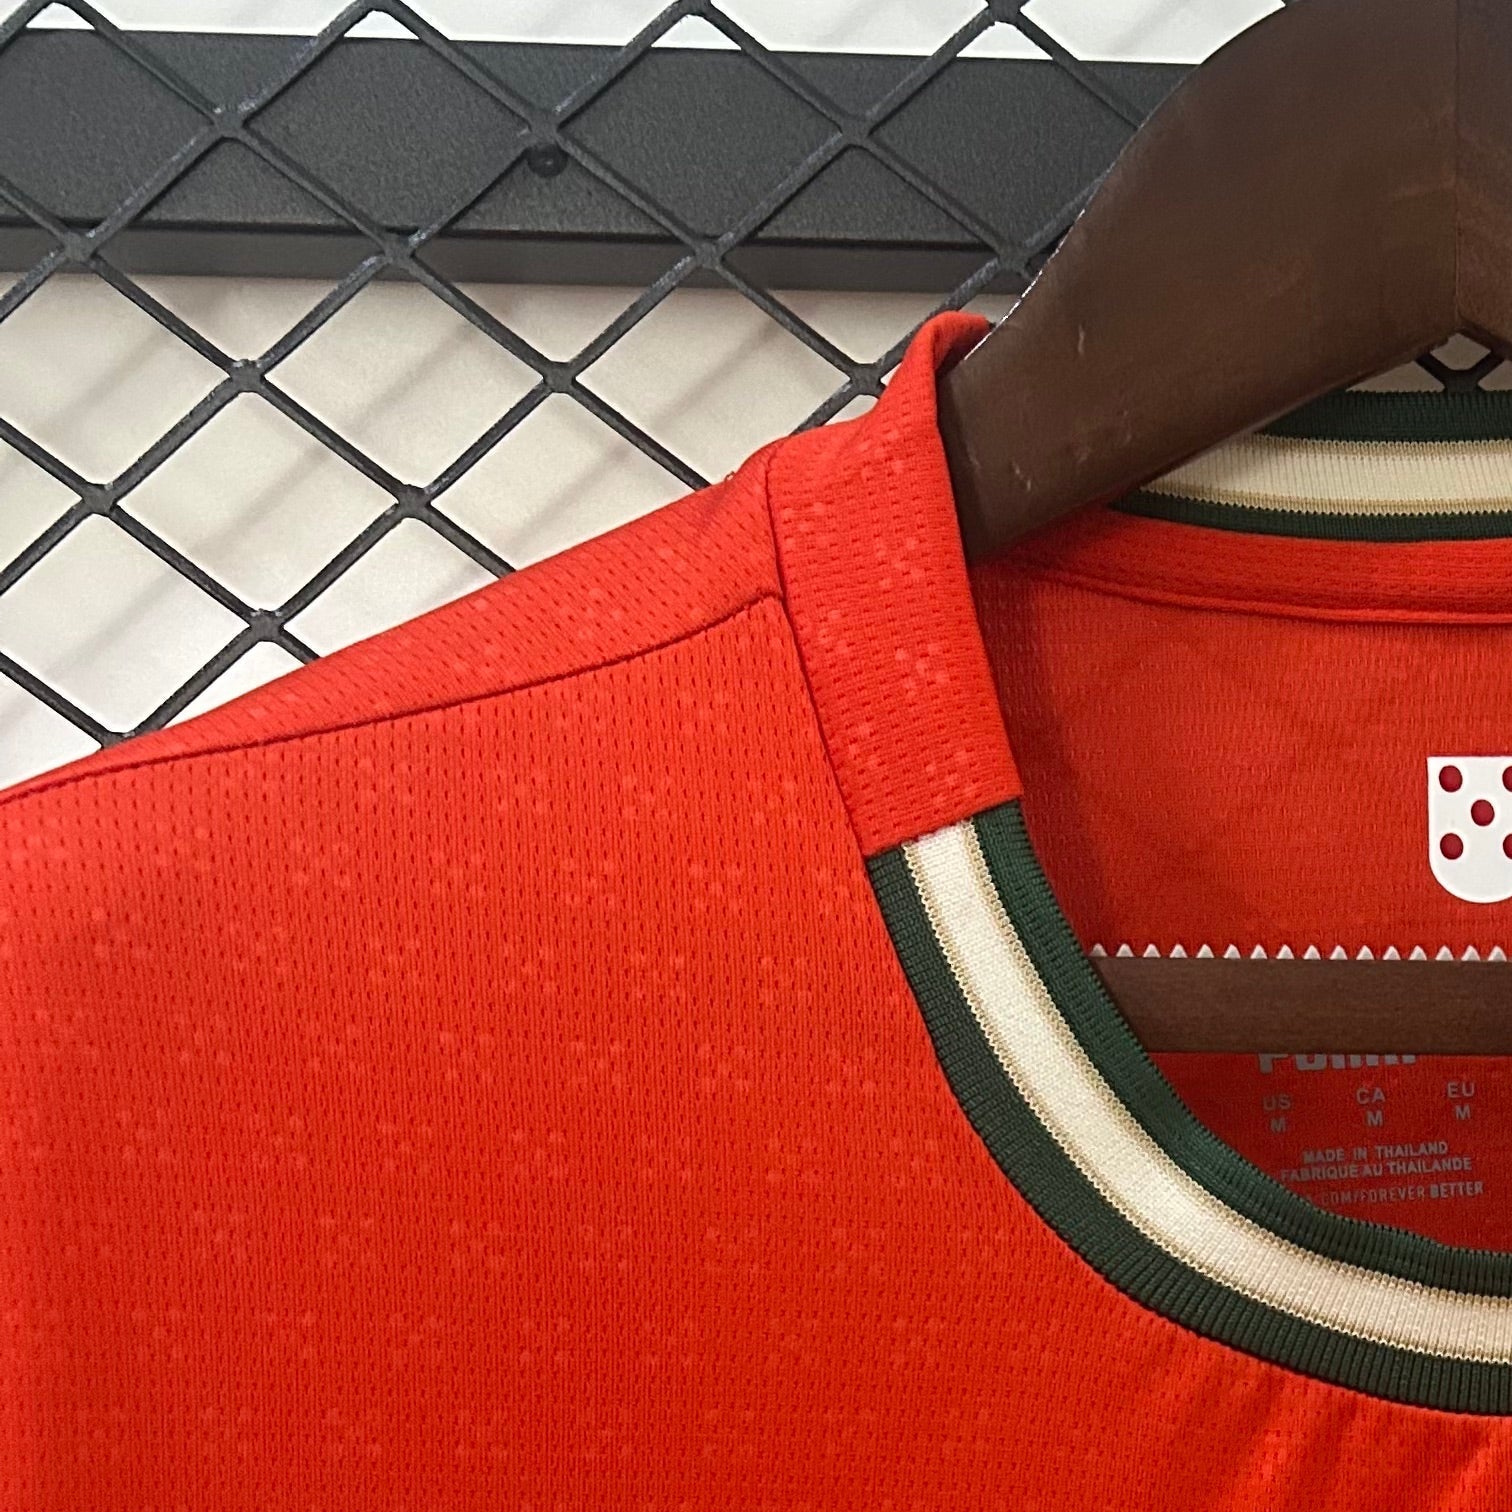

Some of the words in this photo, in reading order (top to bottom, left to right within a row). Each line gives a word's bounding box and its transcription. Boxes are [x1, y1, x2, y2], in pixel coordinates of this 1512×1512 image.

[1262, 1093, 1292, 1112] US
[1356, 1087, 1386, 1105] CA
[1447, 1081, 1476, 1098] EU
[1270, 1117, 1287, 1133] M
[1366, 1110, 1384, 1127] M
[1455, 1105, 1472, 1120] M
[1303, 1147, 1345, 1164] MADE
[1353, 1146, 1368, 1161] IN
[1374, 1140, 1448, 1159] THAILAND
[1281, 1164, 1358, 1182] FABRIQUE
[1361, 1163, 1383, 1177] AU
[1386, 1157, 1472, 1175] THAILANDE
